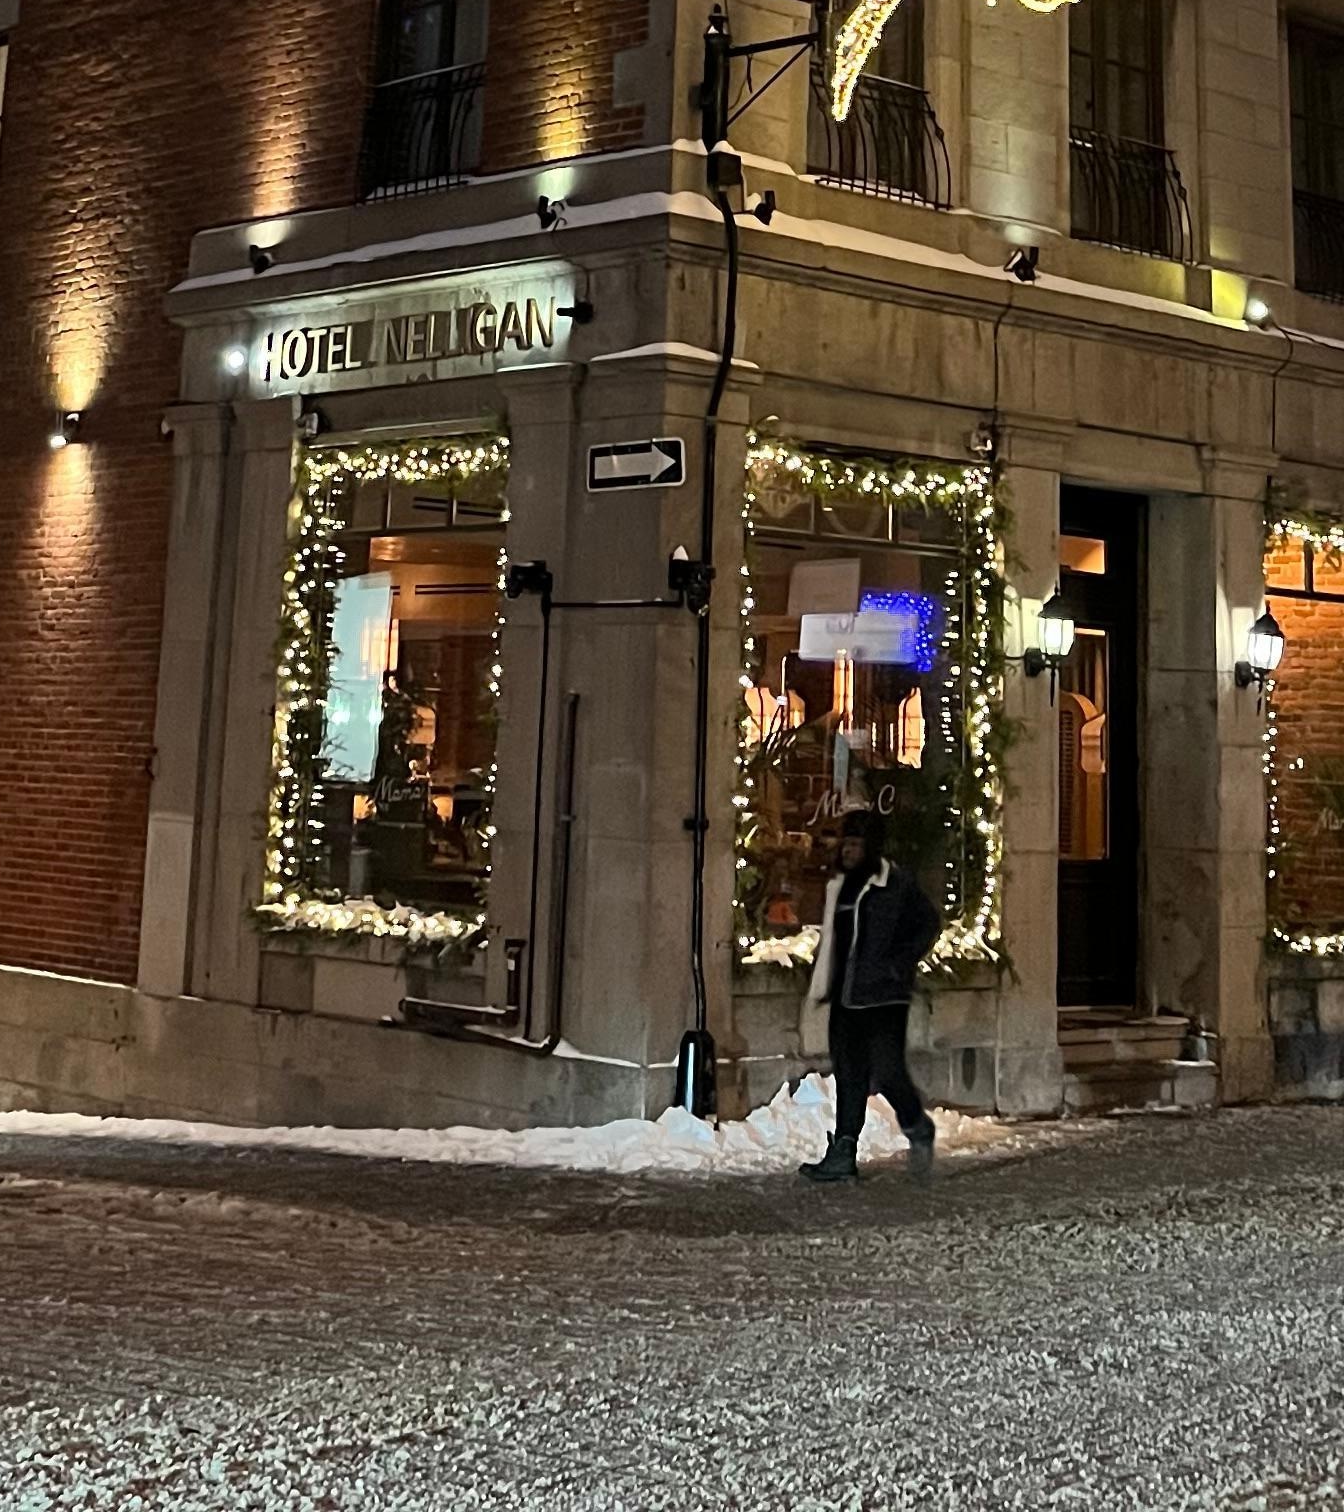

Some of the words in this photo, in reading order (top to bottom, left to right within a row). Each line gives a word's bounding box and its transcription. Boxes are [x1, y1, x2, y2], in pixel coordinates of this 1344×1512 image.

[261, 325, 362, 381] HOTEL
[383, 296, 555, 363] NELLIGAN
[807, 789, 876, 826] Ma
[877, 783, 896, 816] C
